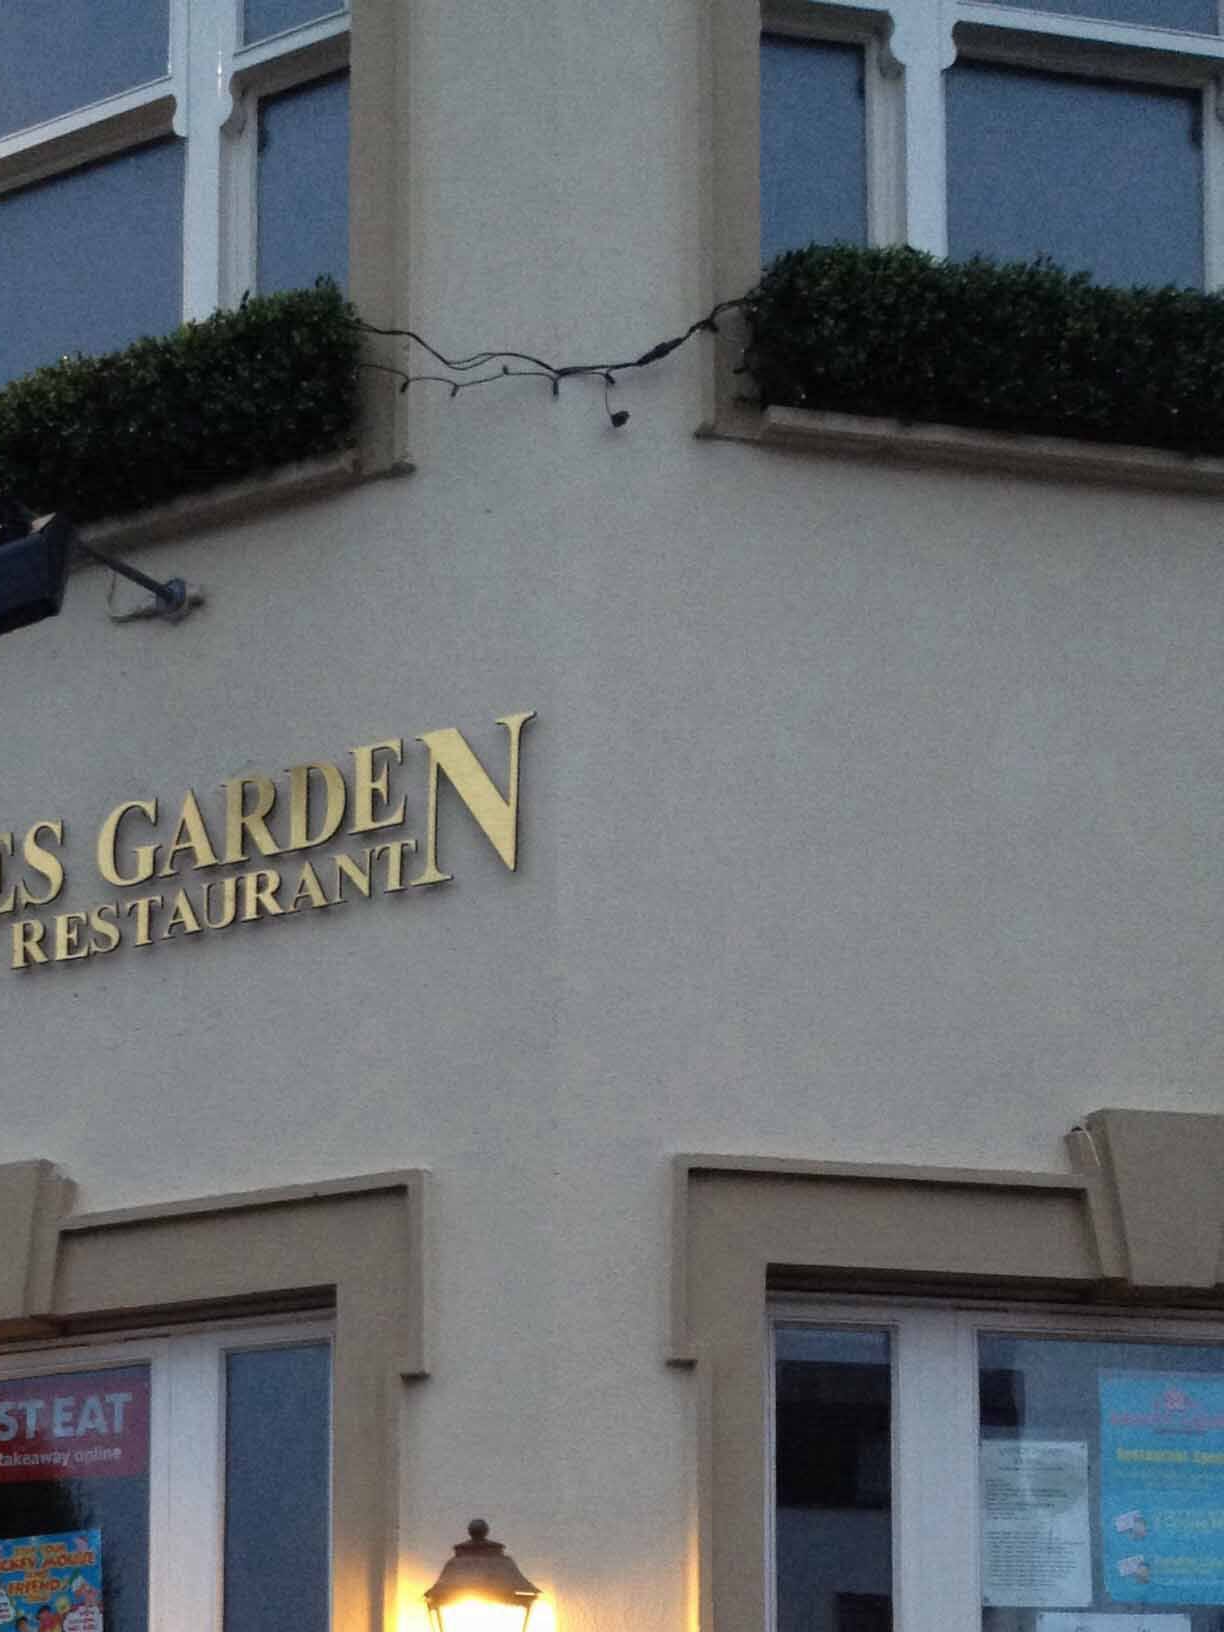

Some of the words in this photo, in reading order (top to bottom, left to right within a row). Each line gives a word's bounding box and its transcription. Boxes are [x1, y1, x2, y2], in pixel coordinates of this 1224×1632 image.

[96, 710, 537, 888] GARDEN
[10, 837, 427, 972] RESTAURANT
[53, 1391, 133, 1438] EAT
[73, 1446, 123, 1466] online
